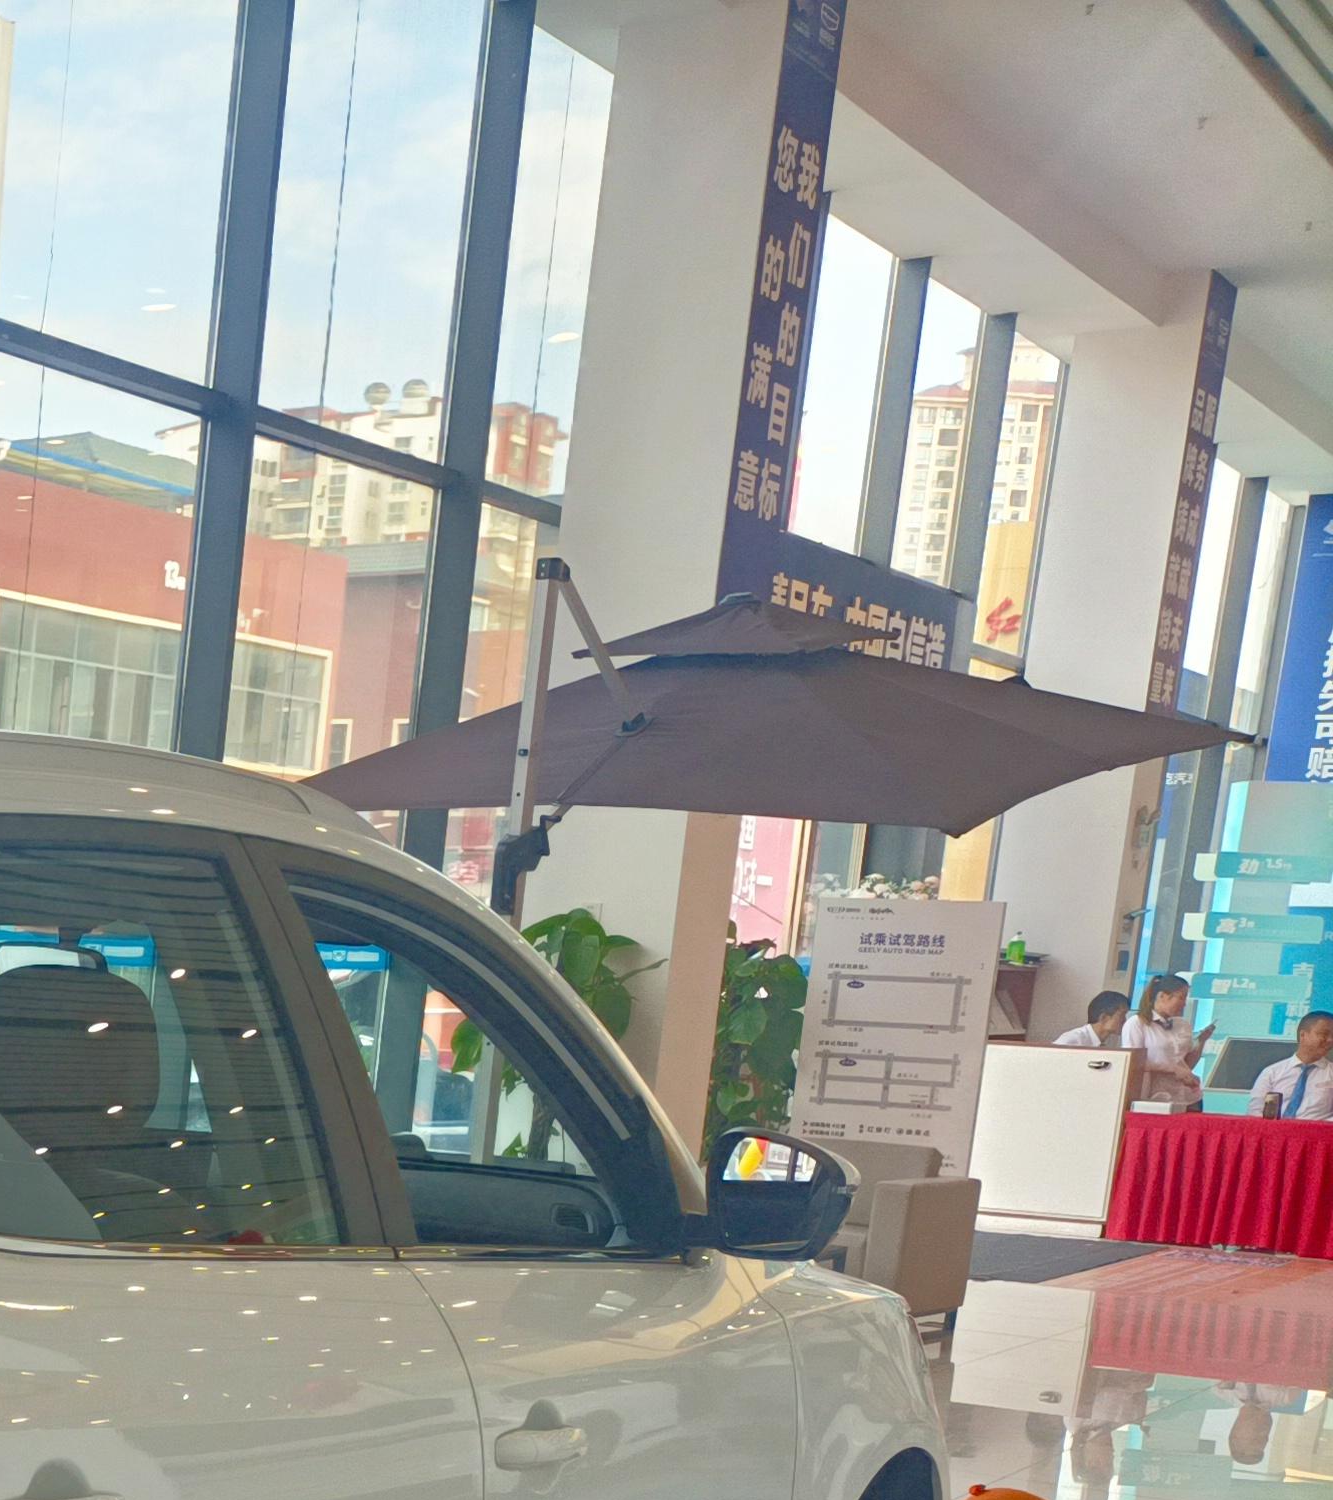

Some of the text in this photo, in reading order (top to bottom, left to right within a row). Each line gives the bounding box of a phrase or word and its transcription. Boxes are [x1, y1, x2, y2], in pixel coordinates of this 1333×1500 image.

[734, 125, 799, 512] 您的满意
[757, 142, 821, 521] 我们的目标
[859, 932, 946, 948] 试乘试驾路线
